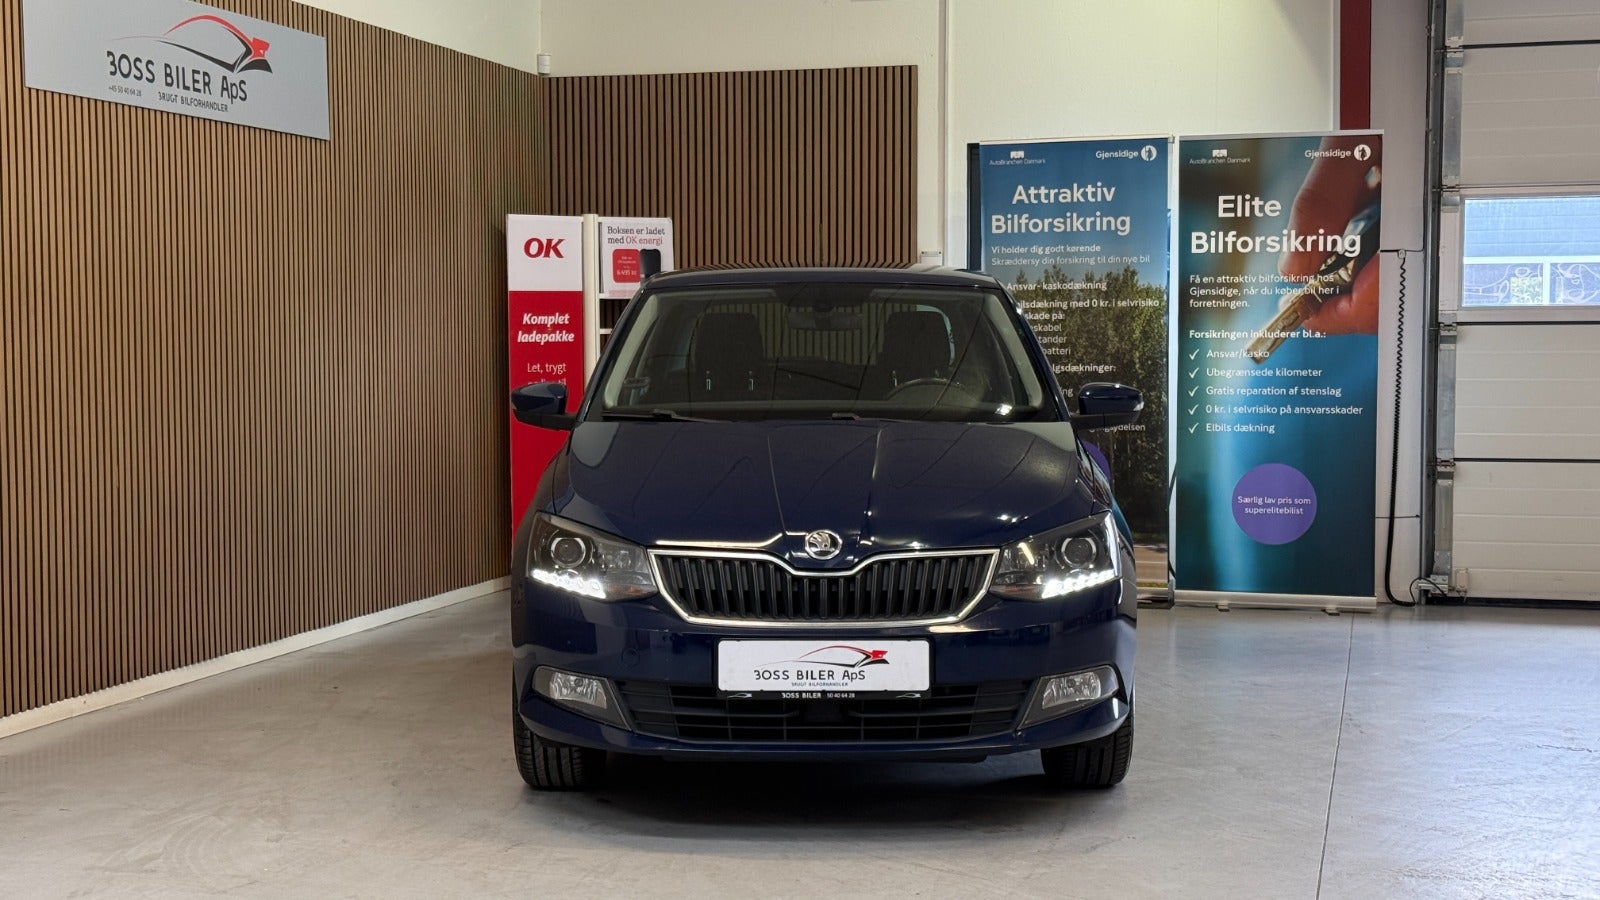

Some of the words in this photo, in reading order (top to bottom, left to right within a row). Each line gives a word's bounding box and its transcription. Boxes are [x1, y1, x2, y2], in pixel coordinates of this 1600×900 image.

[164, 63, 212, 95] BILER
[220, 75, 248, 104] ApS
[181, 96, 228, 112] BILFORHANDLER
[1095, 150, 1139, 160] Gjensidige
[1304, 149, 1352, 159] Gjensidige
[1012, 181, 1116, 205] Attraktiv
[1218, 194, 1282, 218] Elite
[991, 211, 1131, 236] Bilforsikring
[607, 226, 635, 235] Boksen
[646, 226, 666, 236] ladet
[607, 236, 625, 244] med
[626, 236, 638, 244] OK
[639, 237, 663, 247] energi
[1191, 228, 1361, 257] Bilforsikring
[523, 237, 566, 259] OK
[991, 246, 1000, 254] Vi
[1001, 246, 1028, 254] holder
[1030, 245, 1044, 256] dig
[1045, 245, 1065, 255] godt
[1066, 244, 1101, 252] kørende
[991, 257, 1042, 266] Skræddersy
[1044, 257, 1055, 265] din
[1056, 256, 1096, 266] forsikring
[1097, 256, 1107, 264] til
[1108, 256, 1121, 264] din
[1123, 257, 1138, 266] nye
[1139, 255, 1151, 263] bil
[1190, 274, 1201, 284] Få
[1203, 276, 1215, 284] en
[1216, 275, 1257, 284] attraktiv
[1258, 274, 1315, 285] bilforsikring
[1317, 274, 1335, 283] hos
[1006, 282, 1041, 291] Ansvar-
[1043, 281, 1107, 292] kaskodækning
[1190, 287, 1241, 297] Gjensidige,
[1244, 286, 1258, 295] når
[1261, 287, 1273, 295] du
[1275, 286, 1303, 295] køber
[1305, 286, 1316, 295] bil
[1319, 286, 1335, 295] her
[1070, 299, 1090, 309] med
[1092, 299, 1098, 308] 0
[1100, 299, 1111, 308] kr.
[1117, 298, 1160, 308] selvrisiko
[1190, 299, 1250, 309] forretningen.
[522, 312, 570, 329] Komplet
[1052, 311, 1066, 322] på:
[517, 331, 575, 346] ladepakke
[1190, 330, 1249, 341] Forsikringen
[1250, 330, 1301, 339] inkluderer
[1302, 330, 1327, 339] bl.a.:
[1206, 350, 1270, 359] Ansvar/kasko
[528, 362, 544, 374] Let,
[545, 362, 567, 375] trygt
[1206, 368, 1274, 378] Ubegrænsede
[1275, 368, 1323, 377] kilometer
[1206, 387, 1235, 396] Gratis
[1237, 387, 1287, 397] reparation
[1288, 387, 1299, 396] af
[1301, 387, 1342, 398] stenslag
[1206, 405, 1212, 414] 0
[1214, 405, 1226, 414] kr.
[1233, 405, 1278, 414] selvrisiko
[1280, 405, 1292, 416] på
[1294, 405, 1363, 415] ansvarsskader
[1206, 423, 1232, 432] Elbils
[1234, 423, 1276, 434] dækning
[1238, 496, 1263, 506] Særlig
[1265, 496, 1276, 504] lav
[1278, 497, 1293, 506] pris
[1244, 507, 1304, 516] superelitebilist
[796, 670, 835, 681] BILER
[842, 670, 866, 683] ApS
